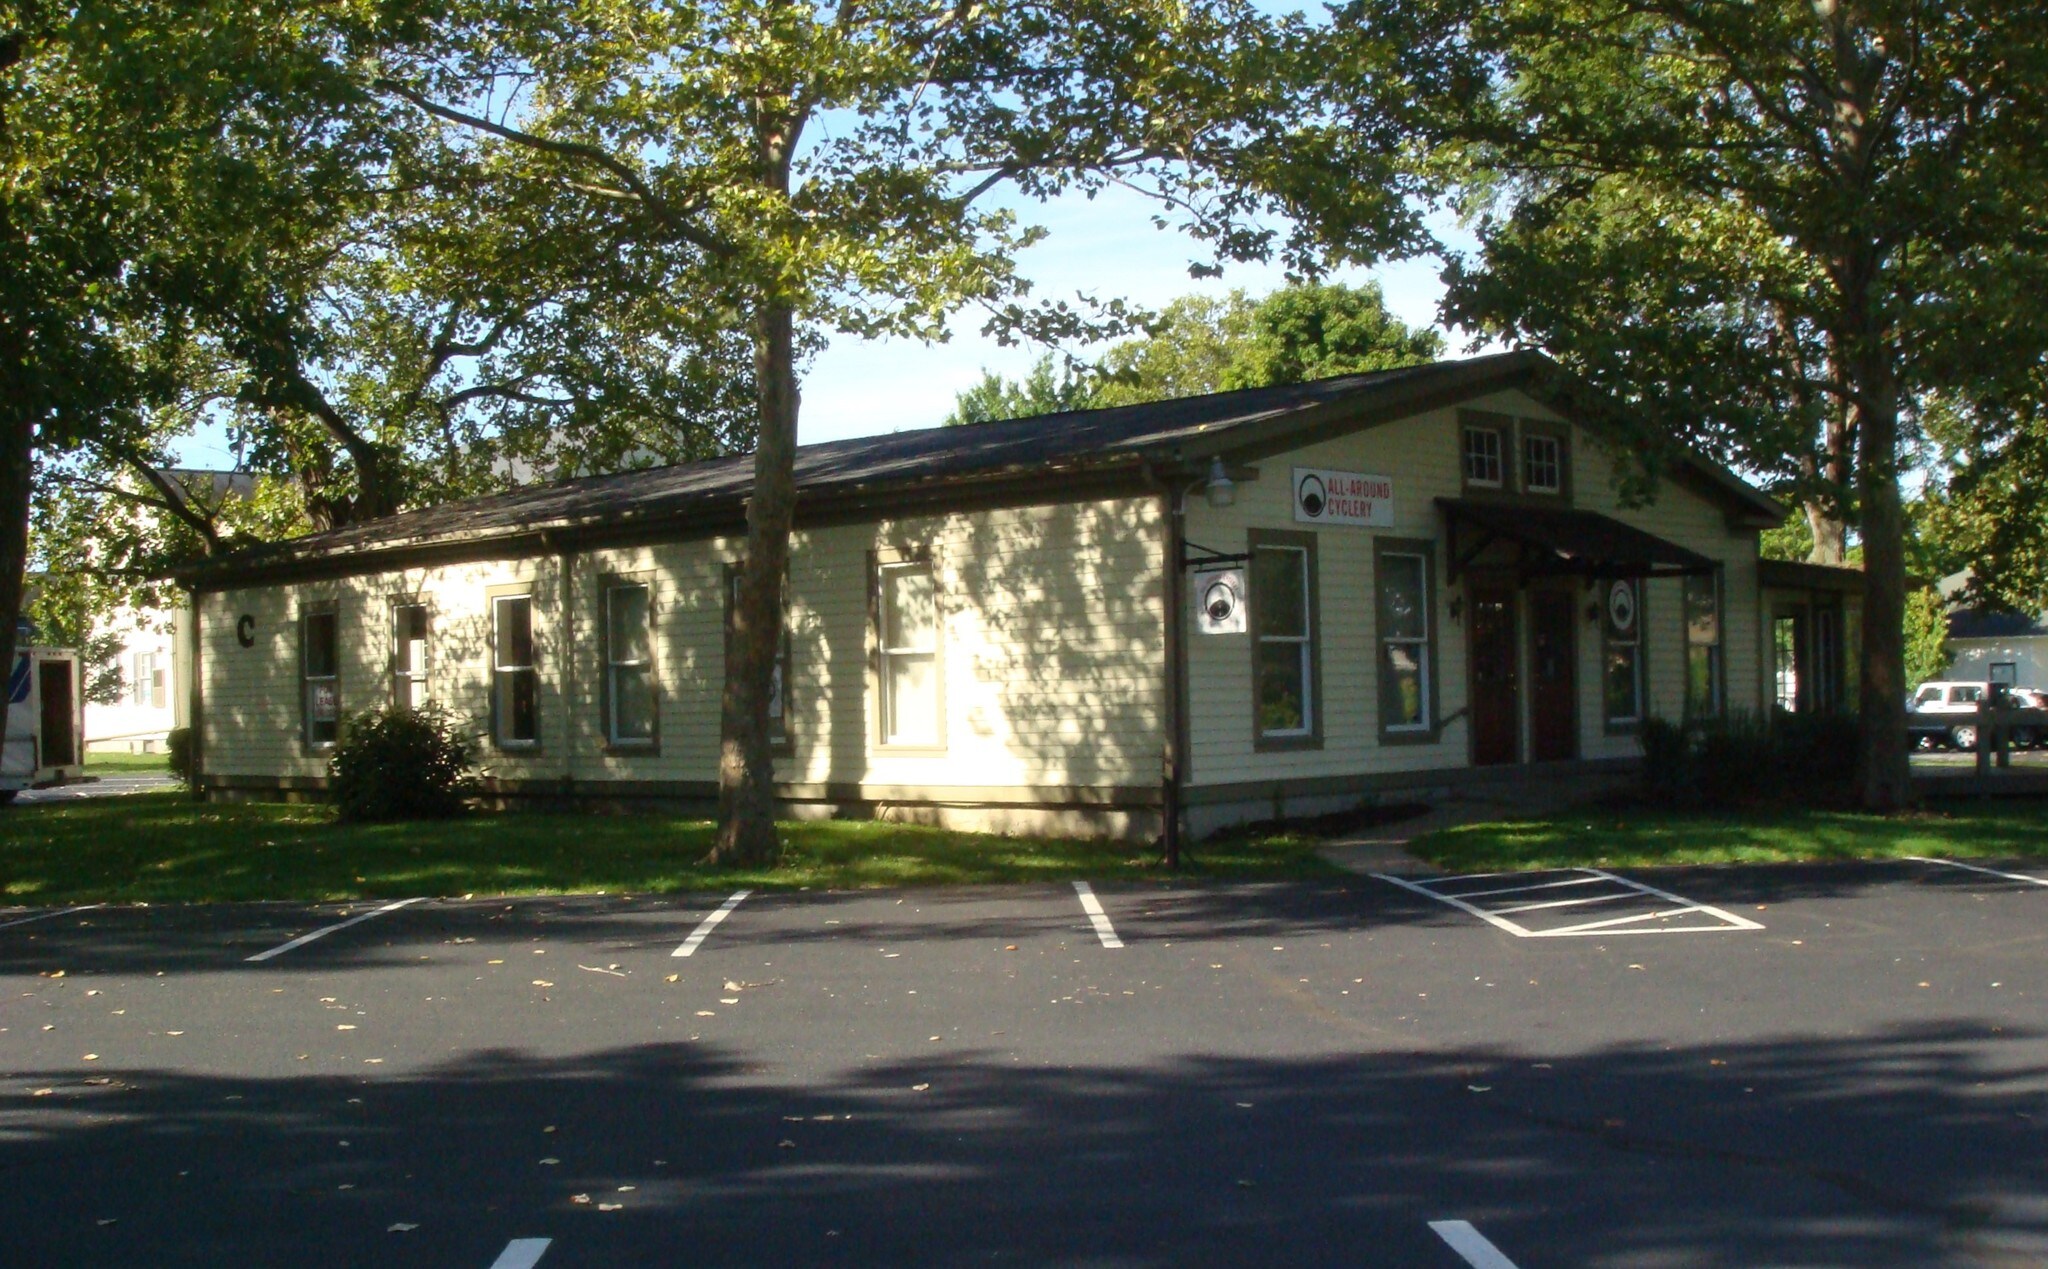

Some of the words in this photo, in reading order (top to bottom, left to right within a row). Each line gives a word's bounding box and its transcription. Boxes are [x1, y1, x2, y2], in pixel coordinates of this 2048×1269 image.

[1328, 478, 1390, 499] ALL-AROUND
[1328, 498, 1371, 517] CYCLERY
[237, 614, 255, 648] C
